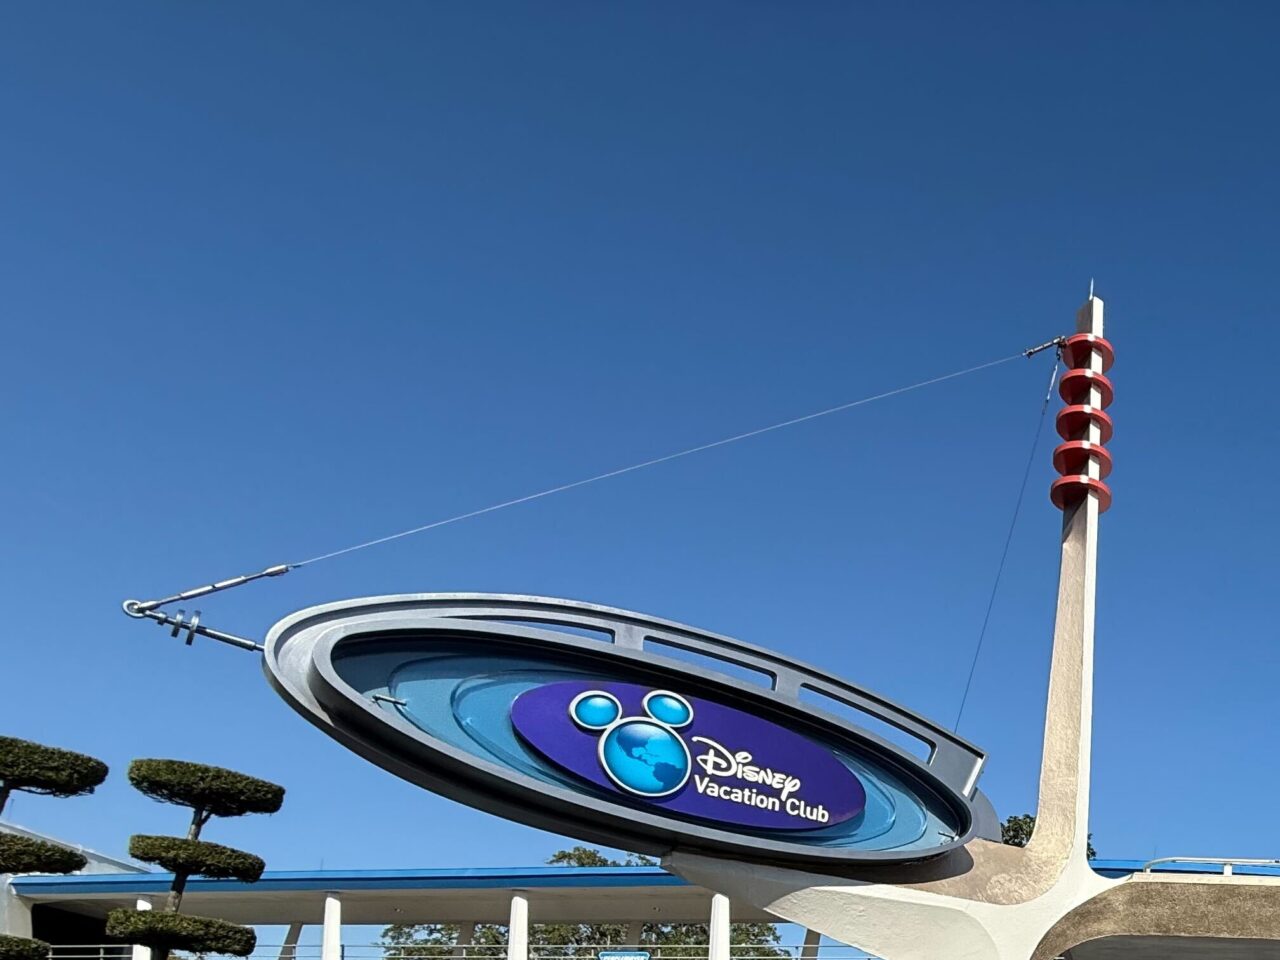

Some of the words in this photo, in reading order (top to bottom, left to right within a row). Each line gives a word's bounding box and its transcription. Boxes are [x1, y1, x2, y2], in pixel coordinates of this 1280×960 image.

[692, 736, 801, 801] Disney
[694, 775, 780, 812] Vacation
[786, 797, 830, 824] Club
